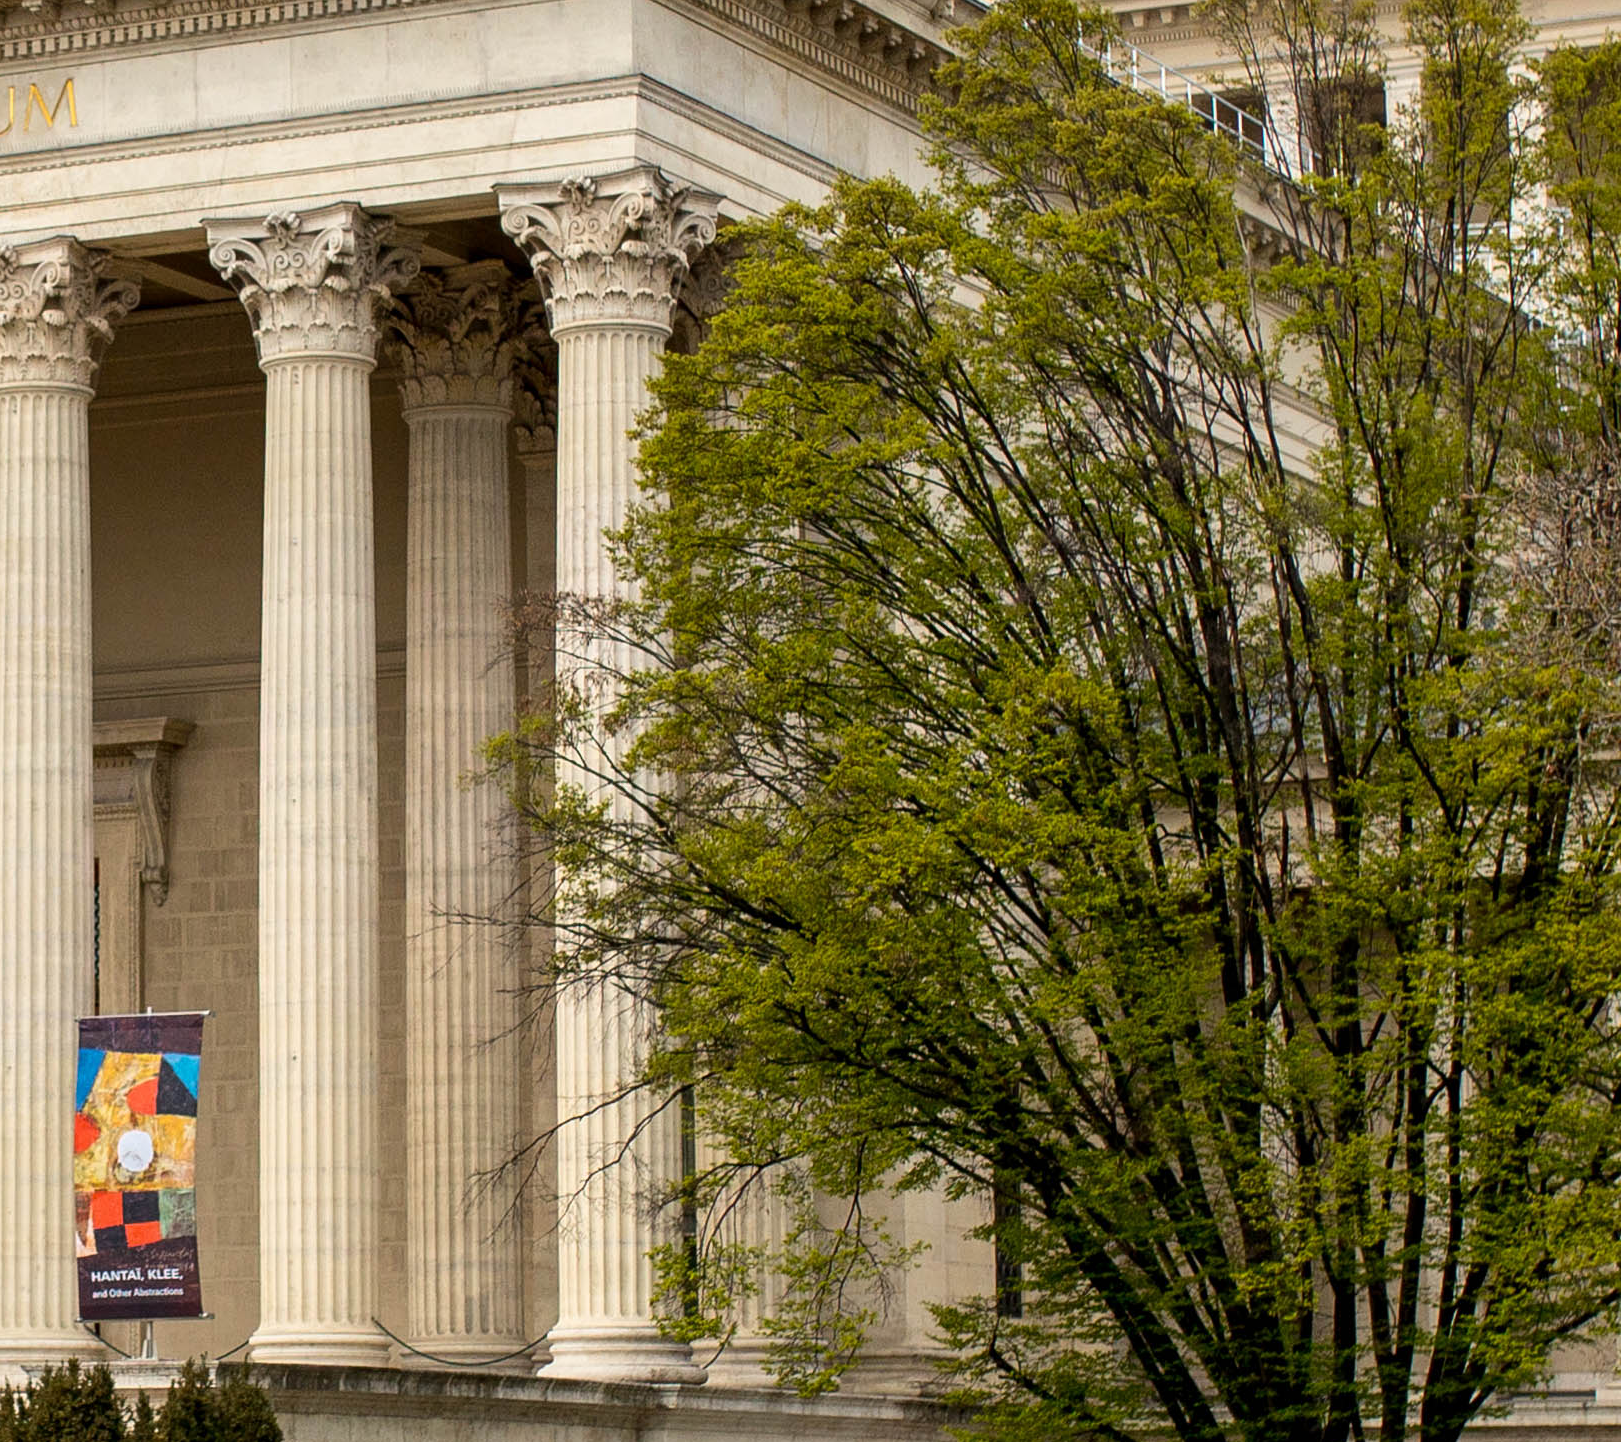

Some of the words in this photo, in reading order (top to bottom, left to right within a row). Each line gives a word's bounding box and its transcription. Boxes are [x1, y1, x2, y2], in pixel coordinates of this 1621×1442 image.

[147, 1267, 184, 1281] KLEE,
[92, 1288, 108, 1299] and
[108, 1288, 132, 1298] Other
[133, 1286, 184, 1297] Abstractions
